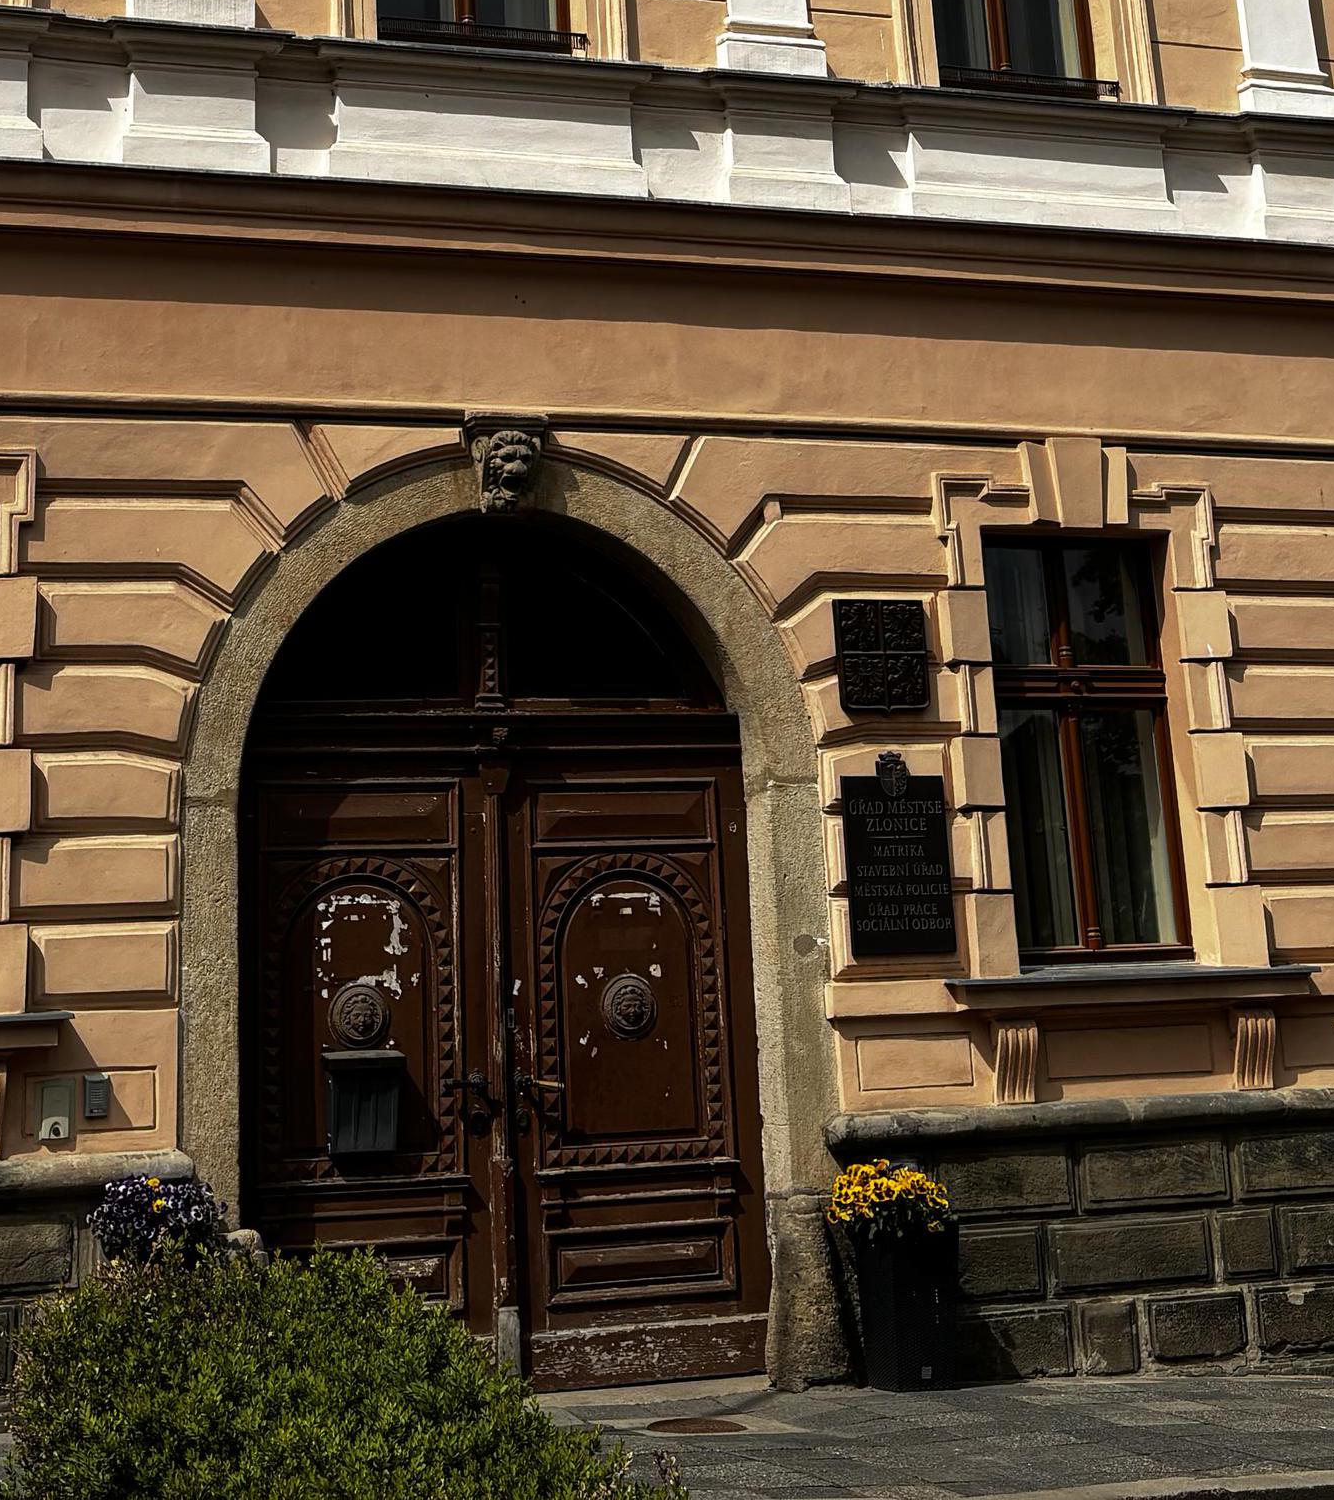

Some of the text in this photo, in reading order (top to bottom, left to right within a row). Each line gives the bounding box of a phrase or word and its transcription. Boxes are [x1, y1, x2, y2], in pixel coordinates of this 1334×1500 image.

[849, 799, 884, 815] ÚŘAD
[866, 817, 928, 832] ZLONICE
[873, 844, 925, 857] MATRIKA
[856, 862, 943, 877] STAVEBNÍ ÚŘAD
[853, 882, 950, 897] MĚSTSKÁ POLICIE
[868, 901, 938, 916] ÚŘAD PRÁCE
[856, 916, 953, 931] SOCIÁLNÍ ODBOR
